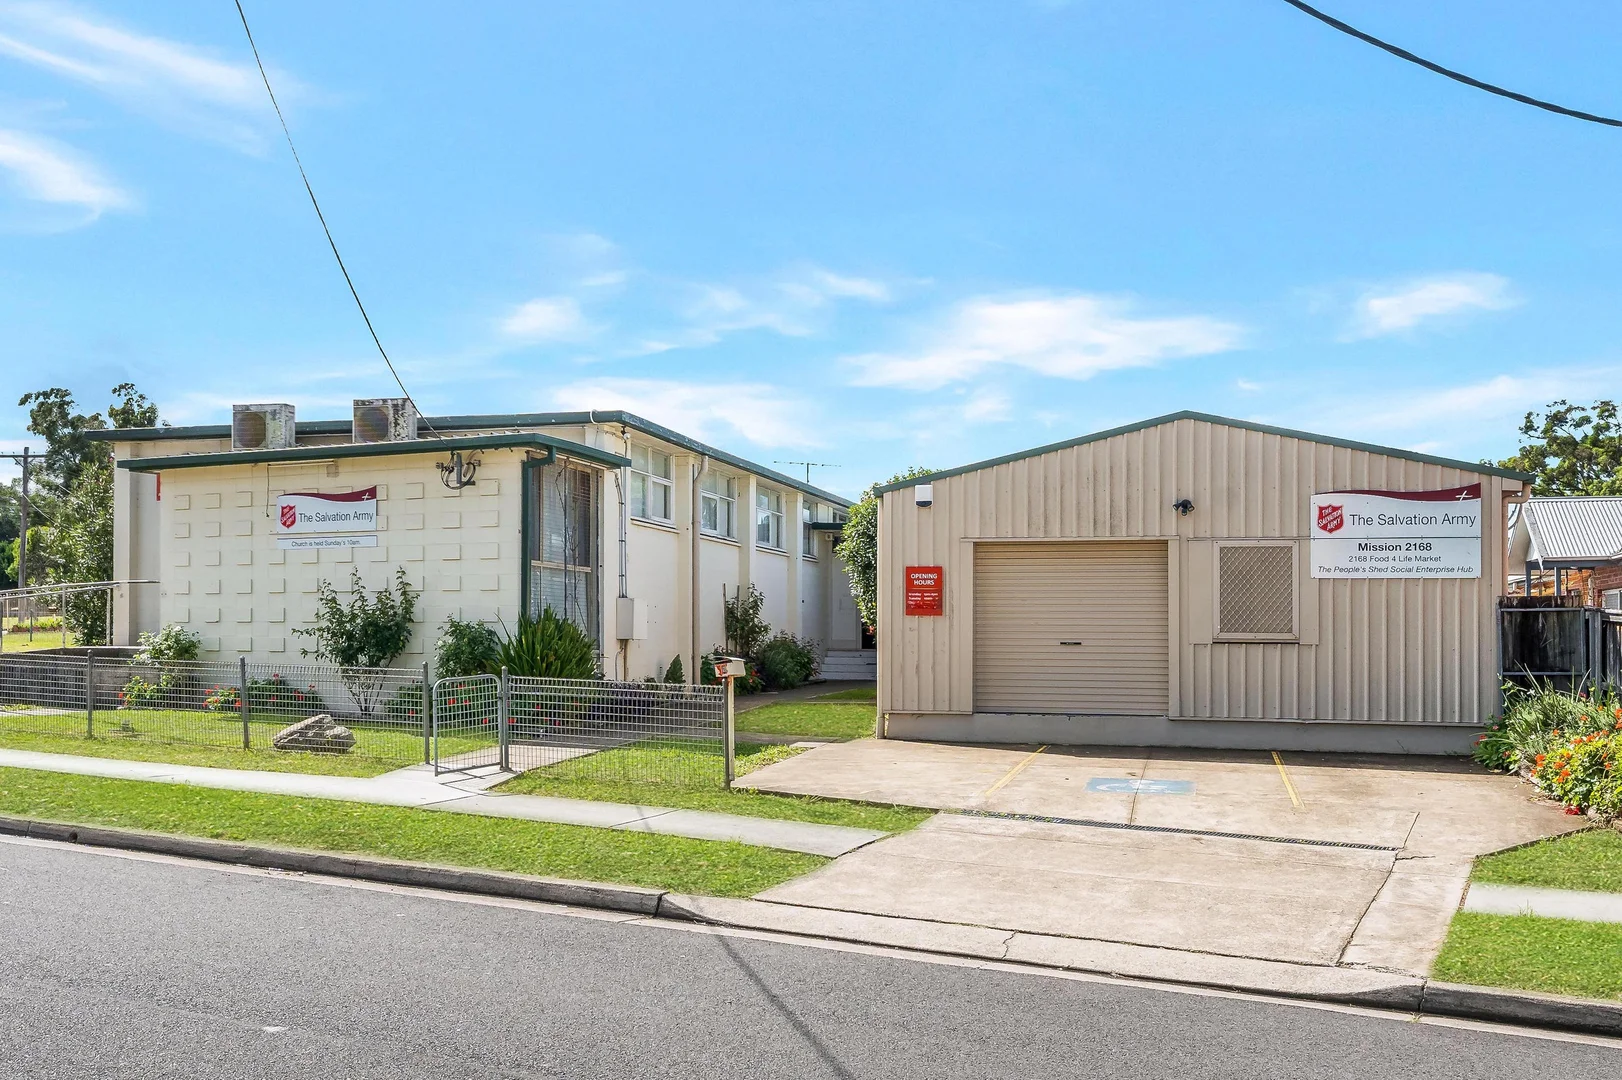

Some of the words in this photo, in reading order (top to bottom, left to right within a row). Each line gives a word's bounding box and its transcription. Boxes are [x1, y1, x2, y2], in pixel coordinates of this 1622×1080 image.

[299, 512, 313, 522] The
[315, 512, 351, 522] Salvation
[352, 511, 374, 522] Army
[1349, 514, 1374, 526] The
[1377, 513, 1437, 526] Salvation
[1441, 513, 1476, 528] Army
[291, 540, 308, 548] Church
[313, 539, 324, 547] held
[324, 539, 346, 548] Sunday's
[1358, 542, 1402, 552] Mission
[1405, 542, 1432, 552] 2168
[1348, 555, 1368, 563] 2168
[1369, 555, 1390, 563] Food
[1318, 565, 1332, 573] The
[1333, 565, 1367, 574] People's
[1368, 565, 1389, 573] Shed
[1390, 565, 1414, 573] Social
[1415, 565, 1455, 574] Enterprise
[1456, 565, 1474, 573] Hub
